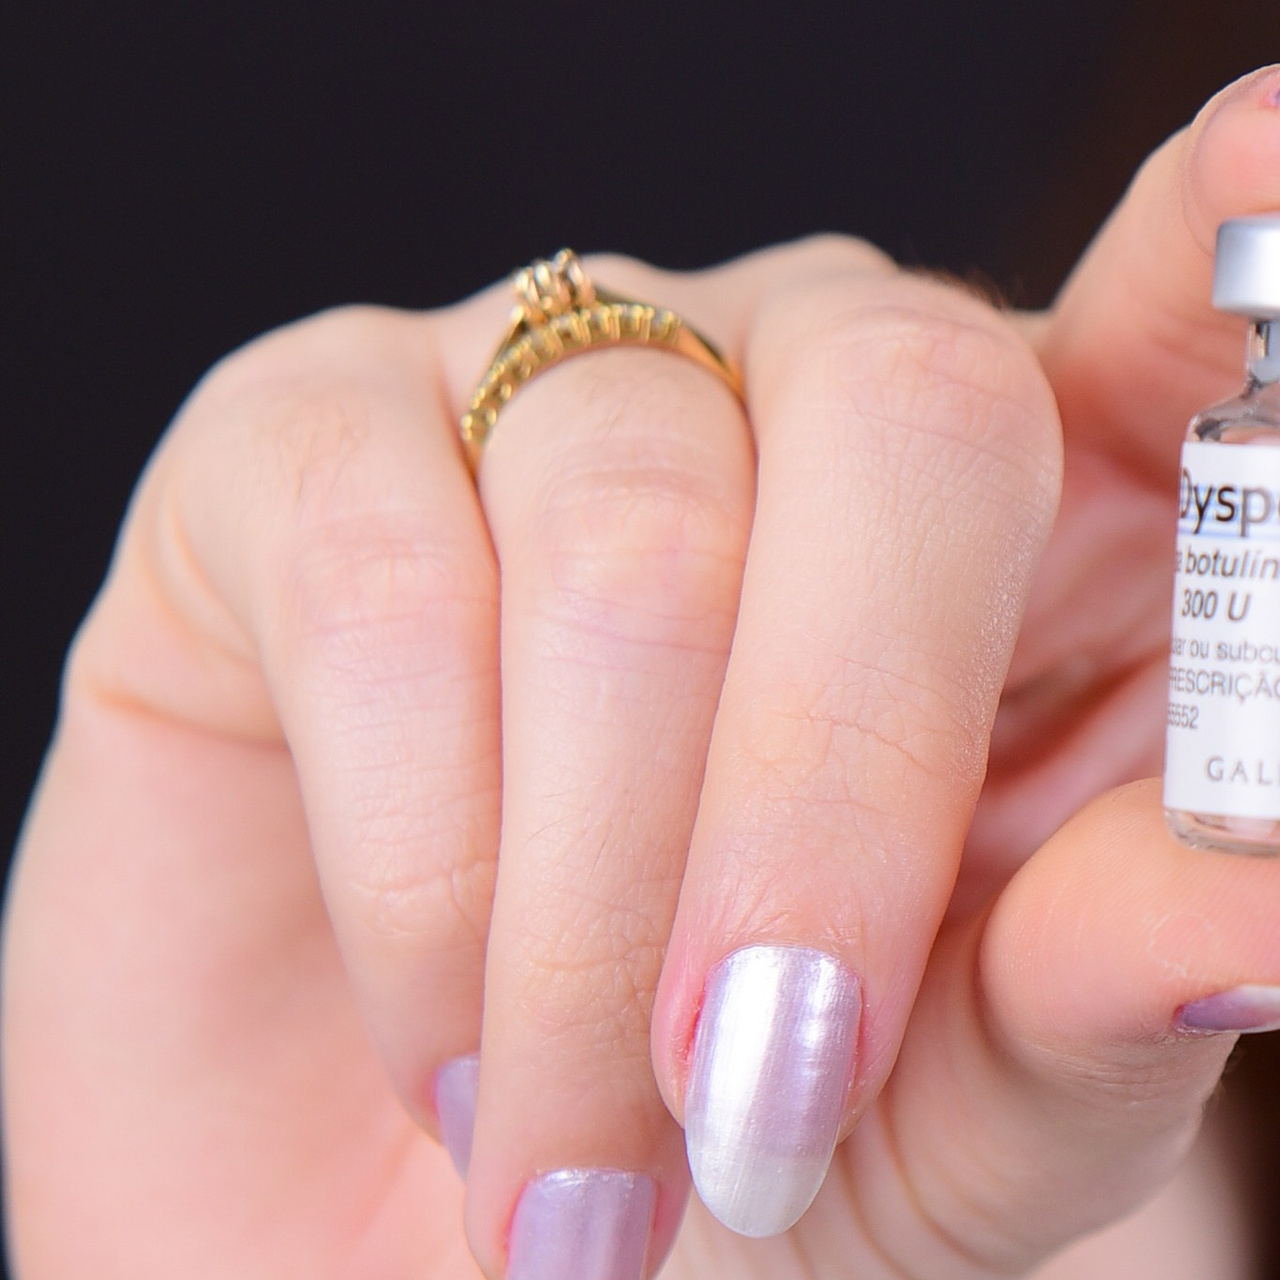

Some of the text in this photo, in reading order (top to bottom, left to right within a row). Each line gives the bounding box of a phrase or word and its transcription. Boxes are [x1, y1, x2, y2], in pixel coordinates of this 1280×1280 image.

[1182, 588, 1251, 622] 300 U
[1189, 640, 1209, 659] ou
